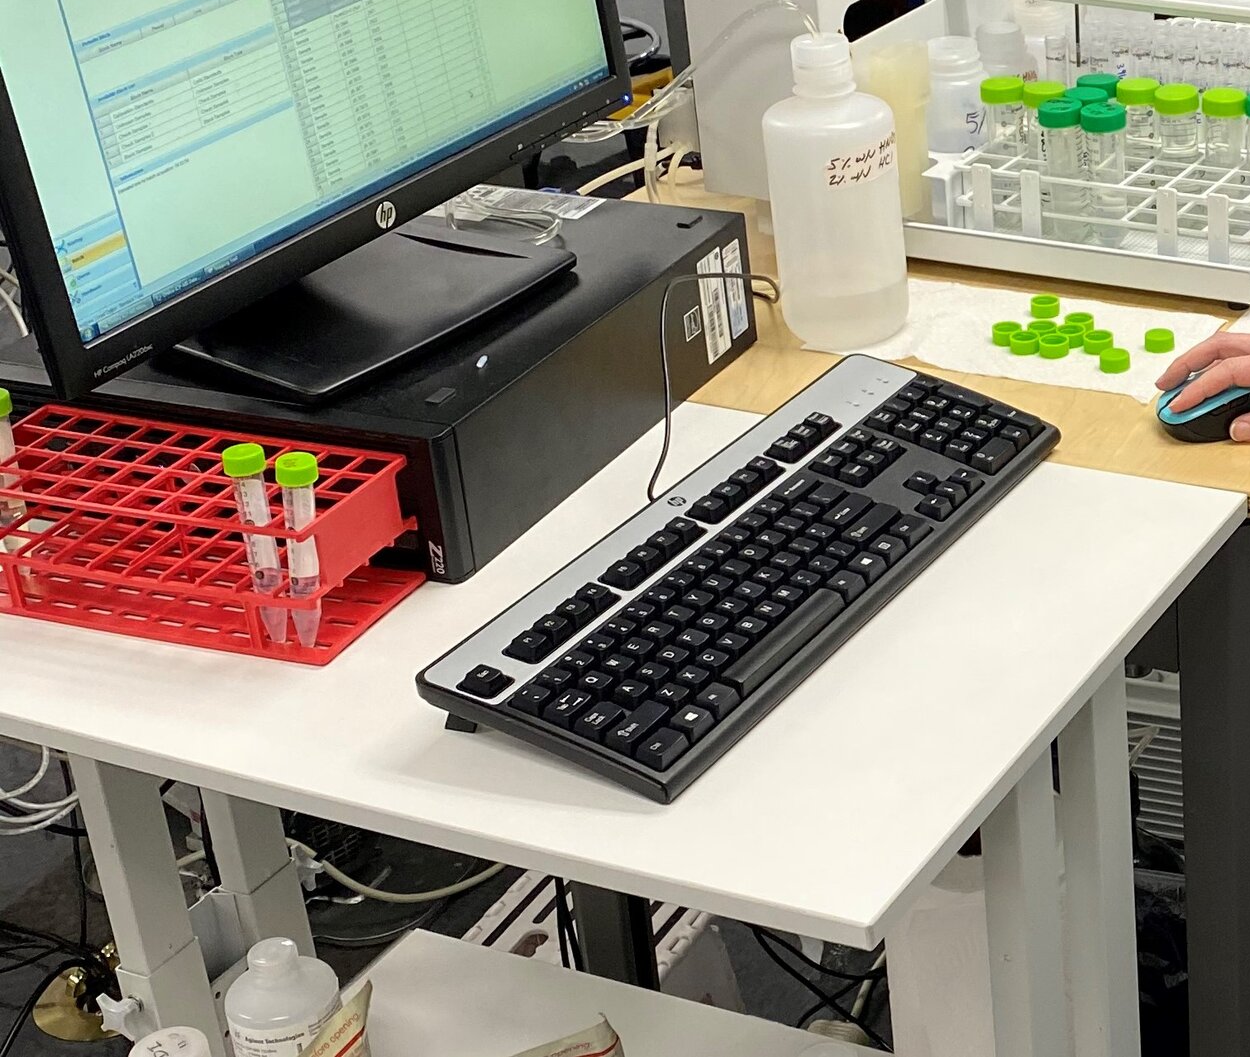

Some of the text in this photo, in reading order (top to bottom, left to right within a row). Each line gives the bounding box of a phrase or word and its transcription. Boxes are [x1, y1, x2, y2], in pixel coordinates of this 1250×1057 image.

[379, 202, 393, 229] hp
[94, 369, 102, 378] HP
[103, 358, 126, 373] Compaq
[428, 540, 446, 575] Z220
